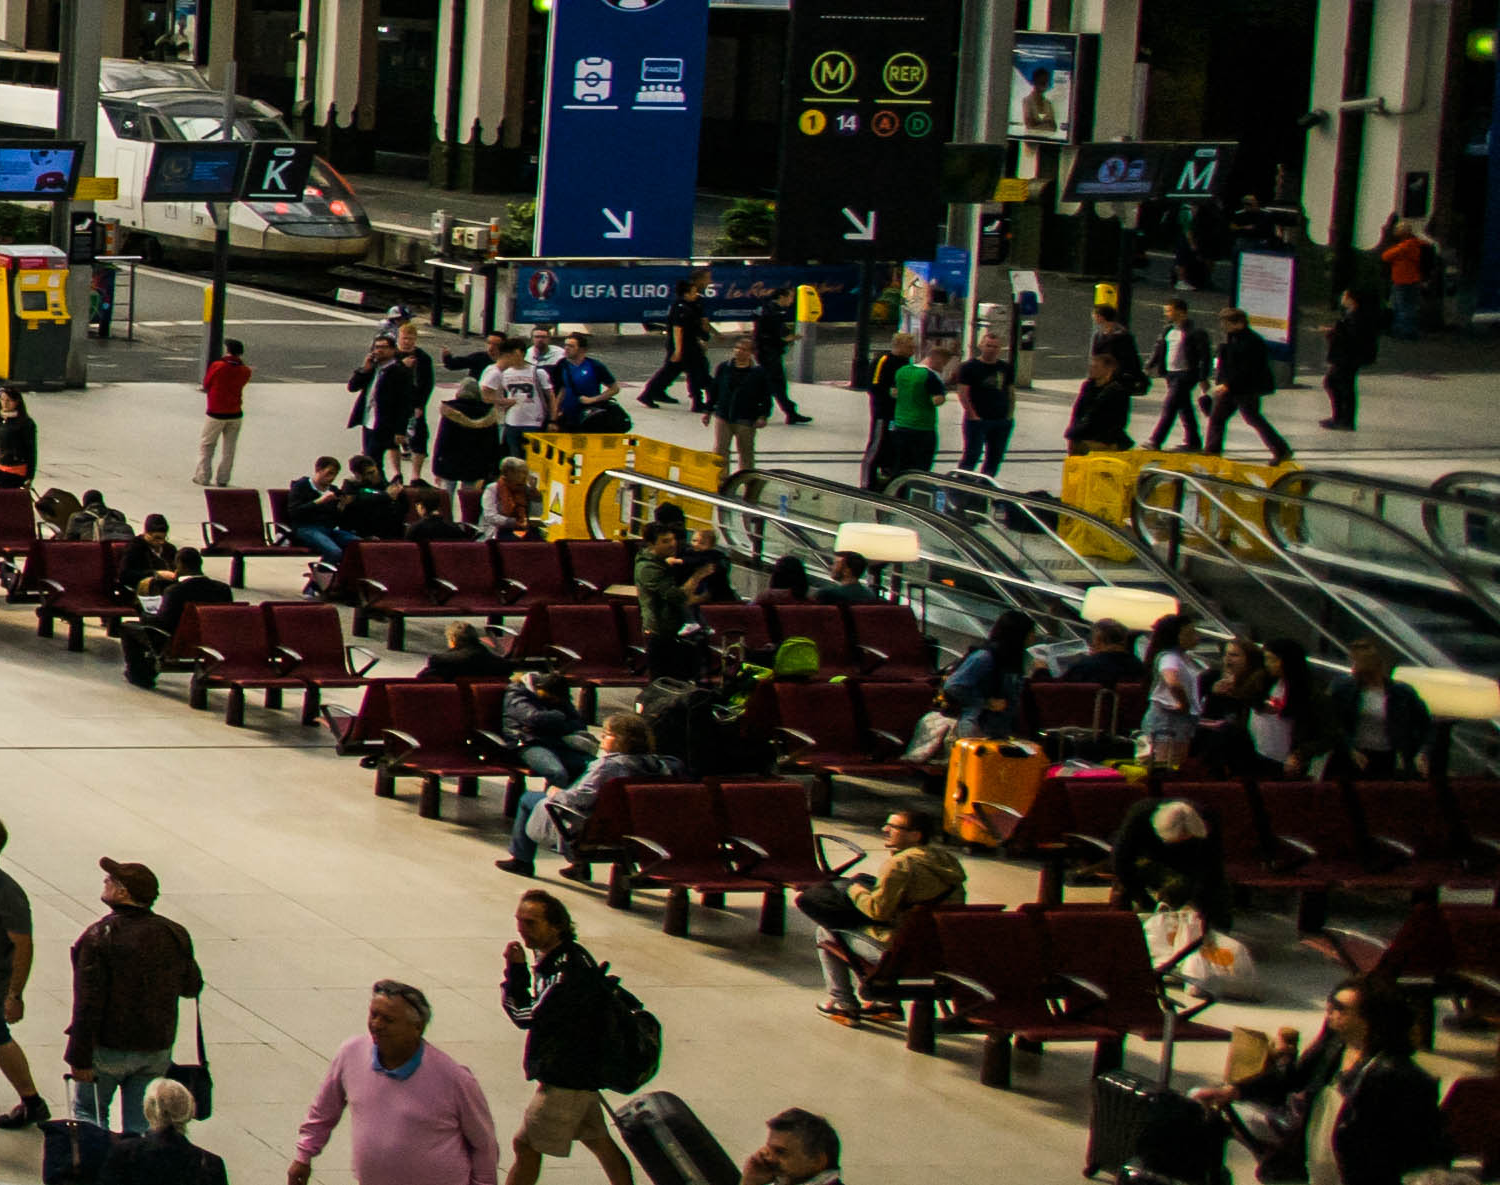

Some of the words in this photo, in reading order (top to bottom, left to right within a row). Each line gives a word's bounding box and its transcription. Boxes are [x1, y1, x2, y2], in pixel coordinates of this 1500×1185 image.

[821, 61, 847, 84] M
[889, 66, 921, 82] RER
[808, 115, 816, 130] 1
[836, 115, 857, 131] 14
[878, 118, 892, 130] A
[911, 117, 924, 131] D
[262, 160, 293, 190] K
[1177, 161, 1217, 190] M
[571, 284, 616, 298] UEFA
[622, 285, 669, 298] EURO
